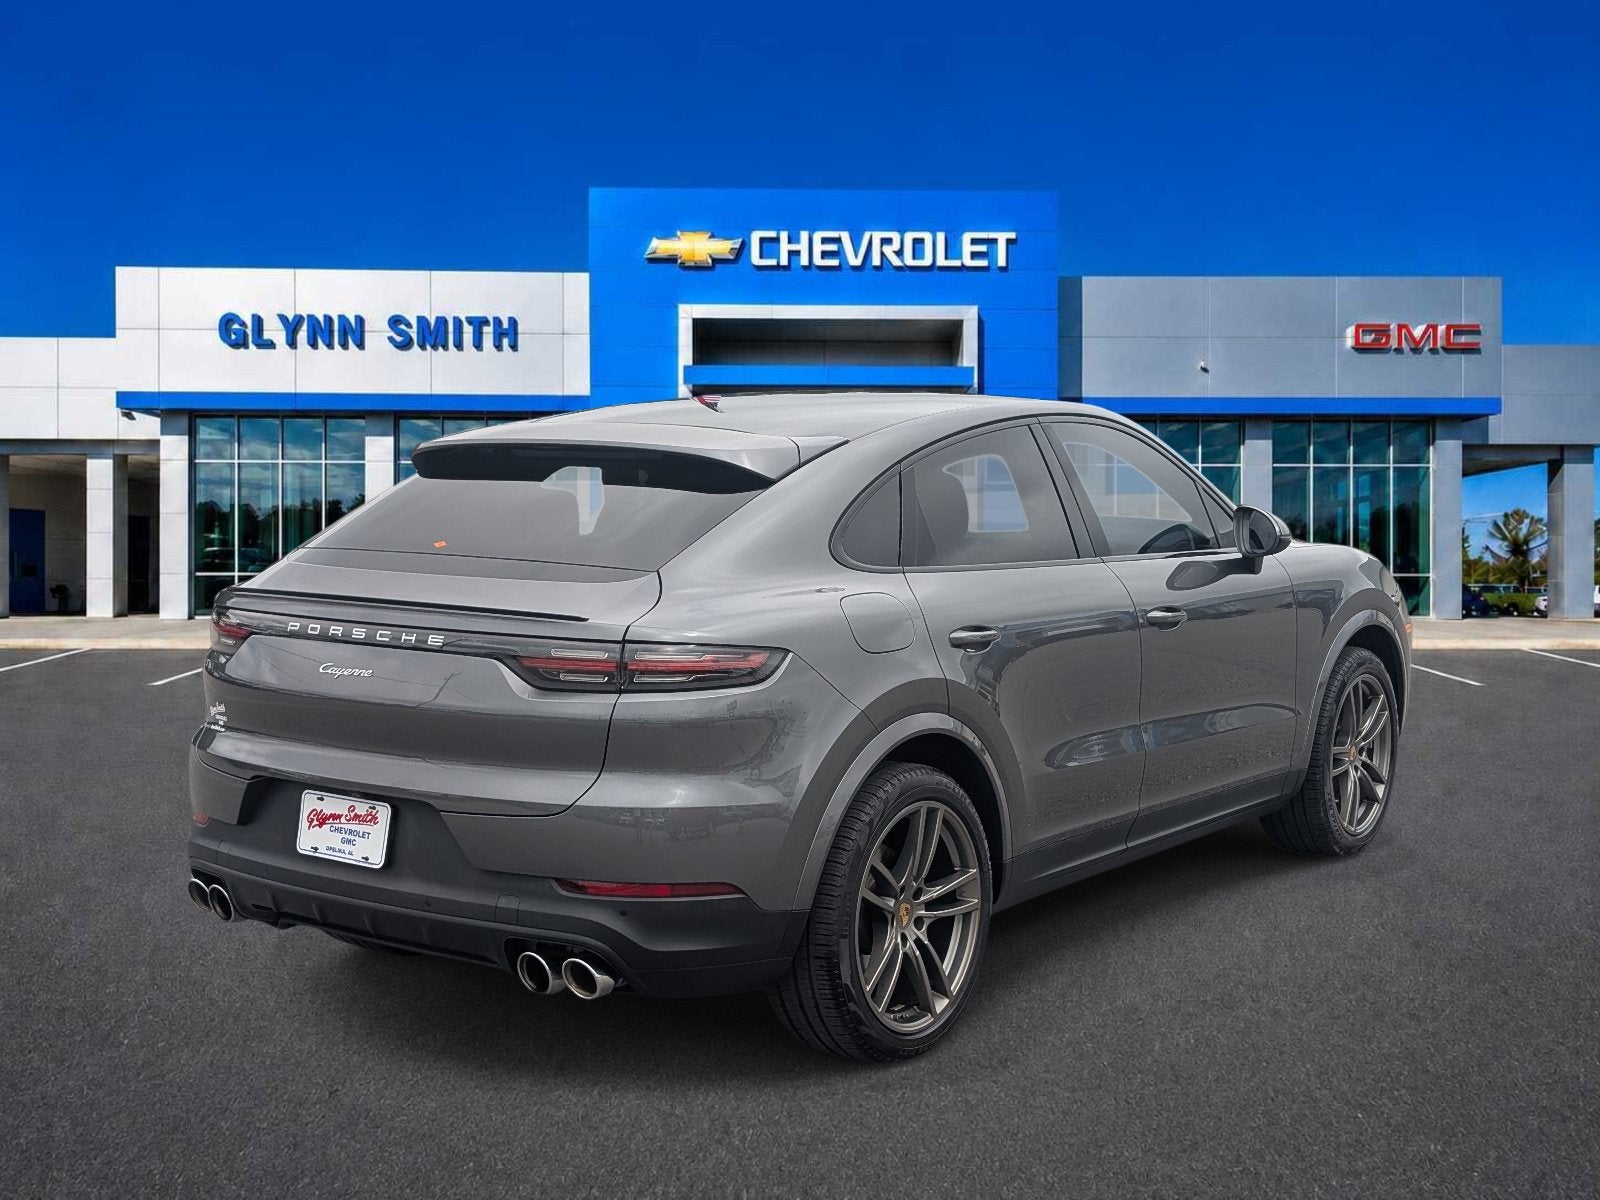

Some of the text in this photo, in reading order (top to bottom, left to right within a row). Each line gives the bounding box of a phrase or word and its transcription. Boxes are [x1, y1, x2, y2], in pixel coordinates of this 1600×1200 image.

[750, 230, 1016, 269] CHEVROLET
[218, 312, 519, 352] GLYNN SMITH
[1349, 322, 1482, 352] GMC
[287, 622, 445, 646] PORSCHE
[319, 662, 374, 679] Cayenne
[306, 804, 380, 830] Glynn Smith
[329, 825, 372, 840] CHEVROLET
[340, 836, 357, 847] GMC
